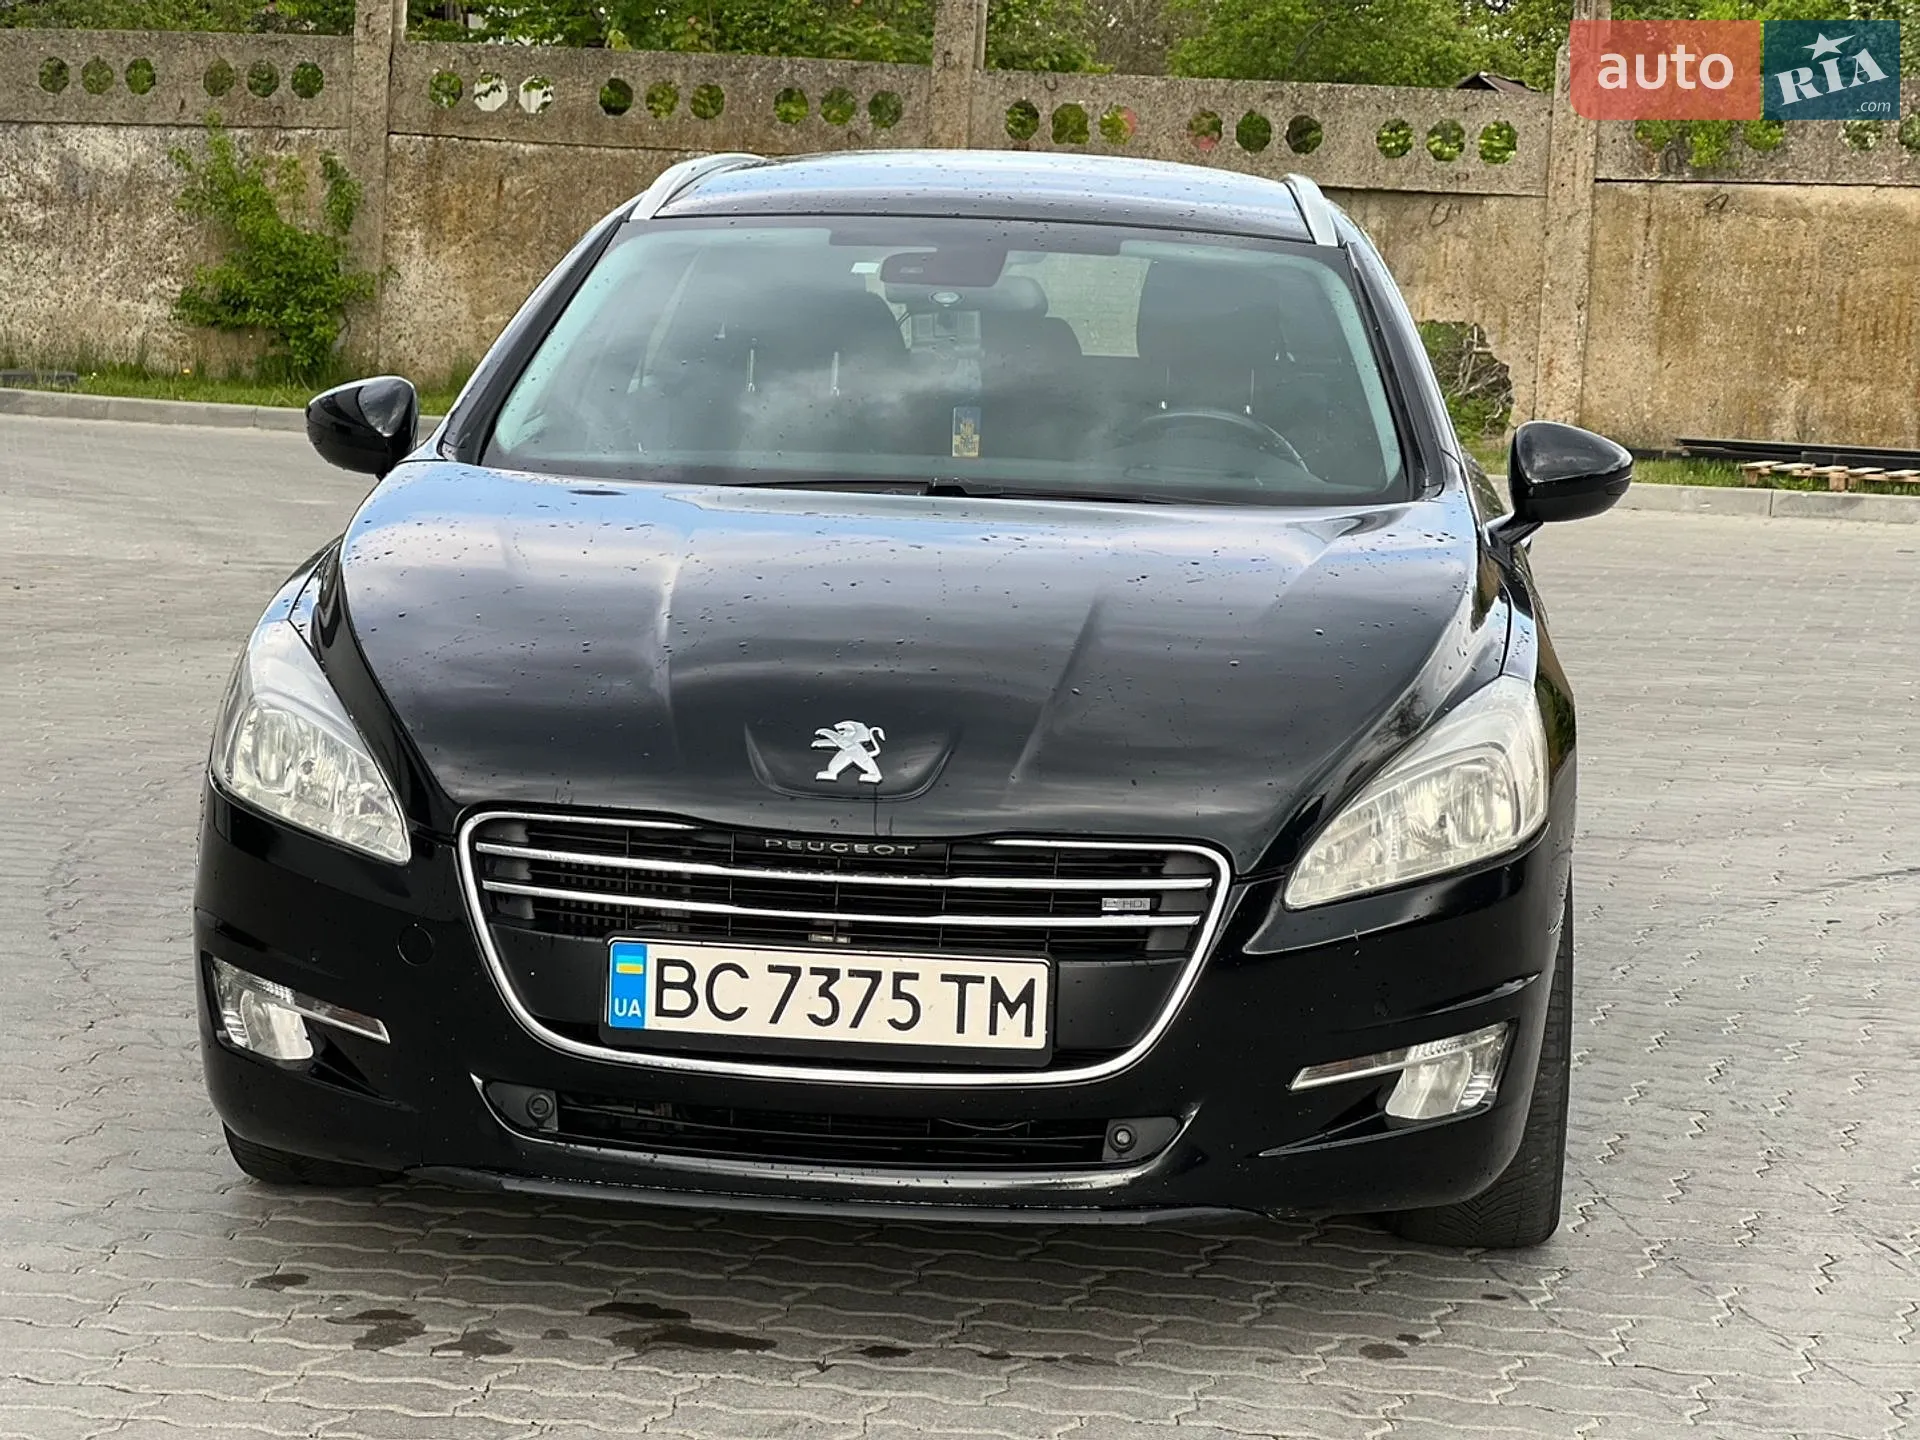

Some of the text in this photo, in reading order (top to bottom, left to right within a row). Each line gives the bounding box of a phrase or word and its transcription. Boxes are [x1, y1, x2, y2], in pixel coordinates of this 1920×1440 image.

[764, 839, 916, 855] PEUGEOT
[614, 997, 642, 1018] UA
[654, 958, 1036, 1038] BC 7375 TM
